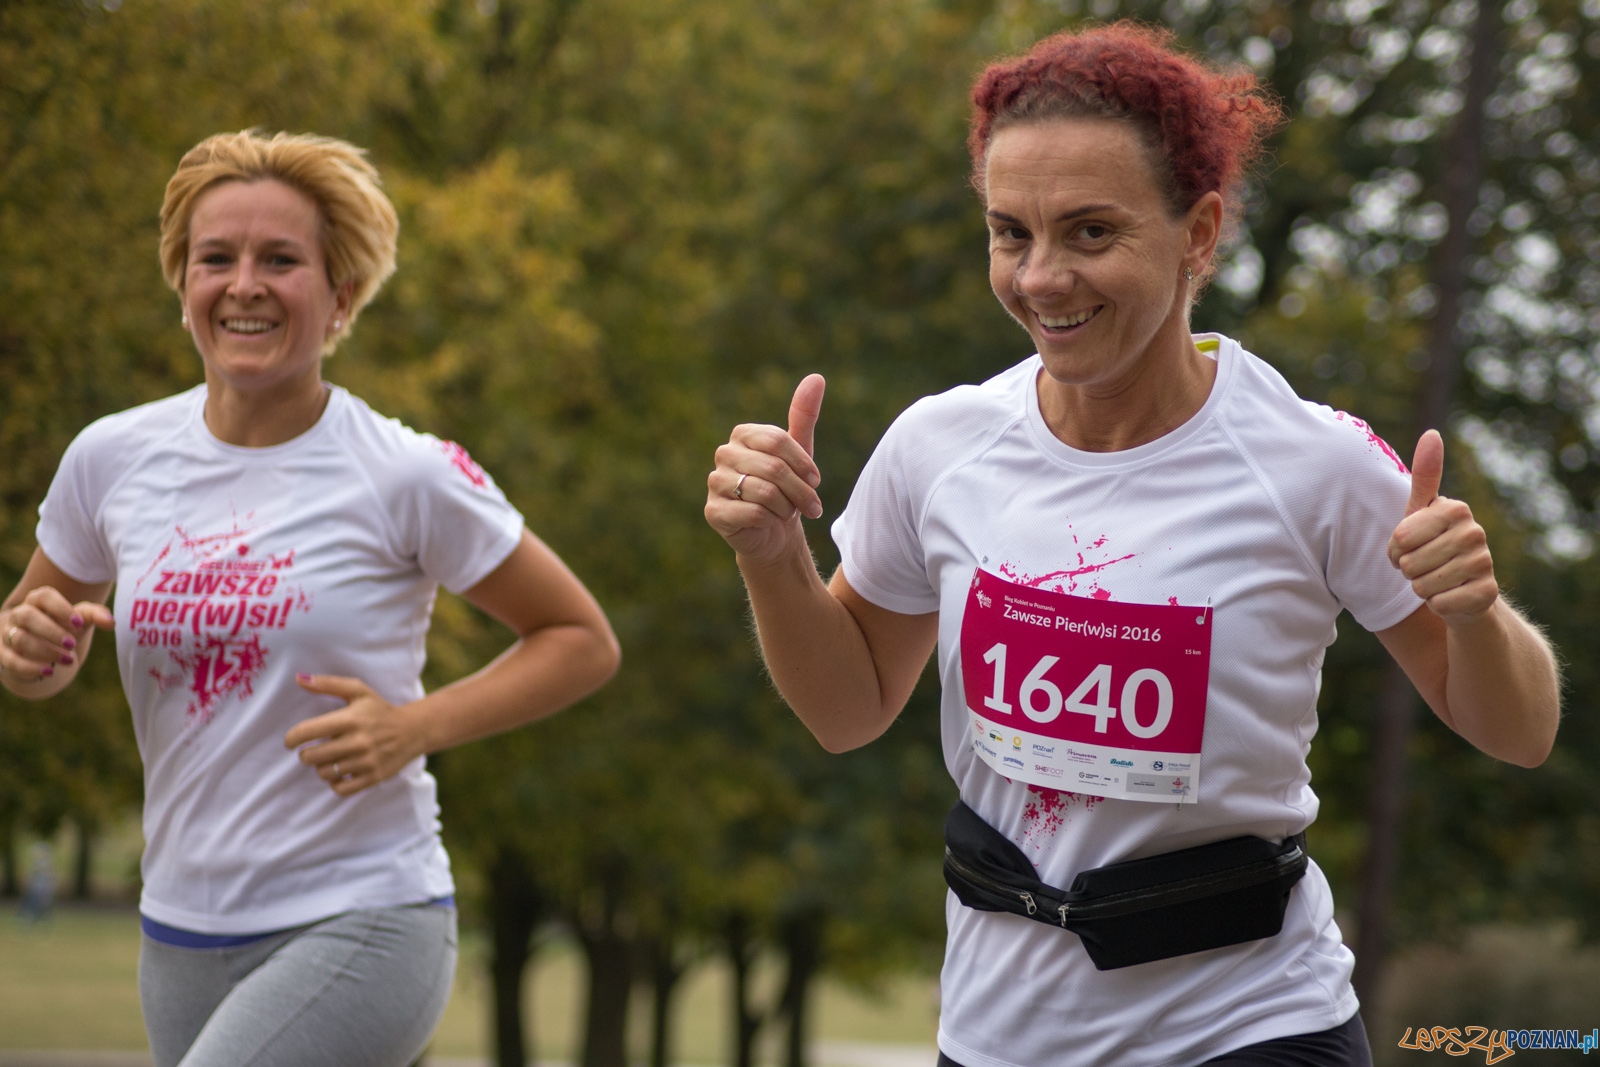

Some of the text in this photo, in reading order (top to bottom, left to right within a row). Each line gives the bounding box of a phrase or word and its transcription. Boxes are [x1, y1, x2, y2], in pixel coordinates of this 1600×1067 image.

[152, 570, 278, 597] zawsze
[130, 598, 294, 637] pier(w)si!
[1003, 604, 1162, 642] Zawsze Pier(w)si 2016
[137, 630, 182, 647] 2016
[982, 641, 1174, 739] 1640
